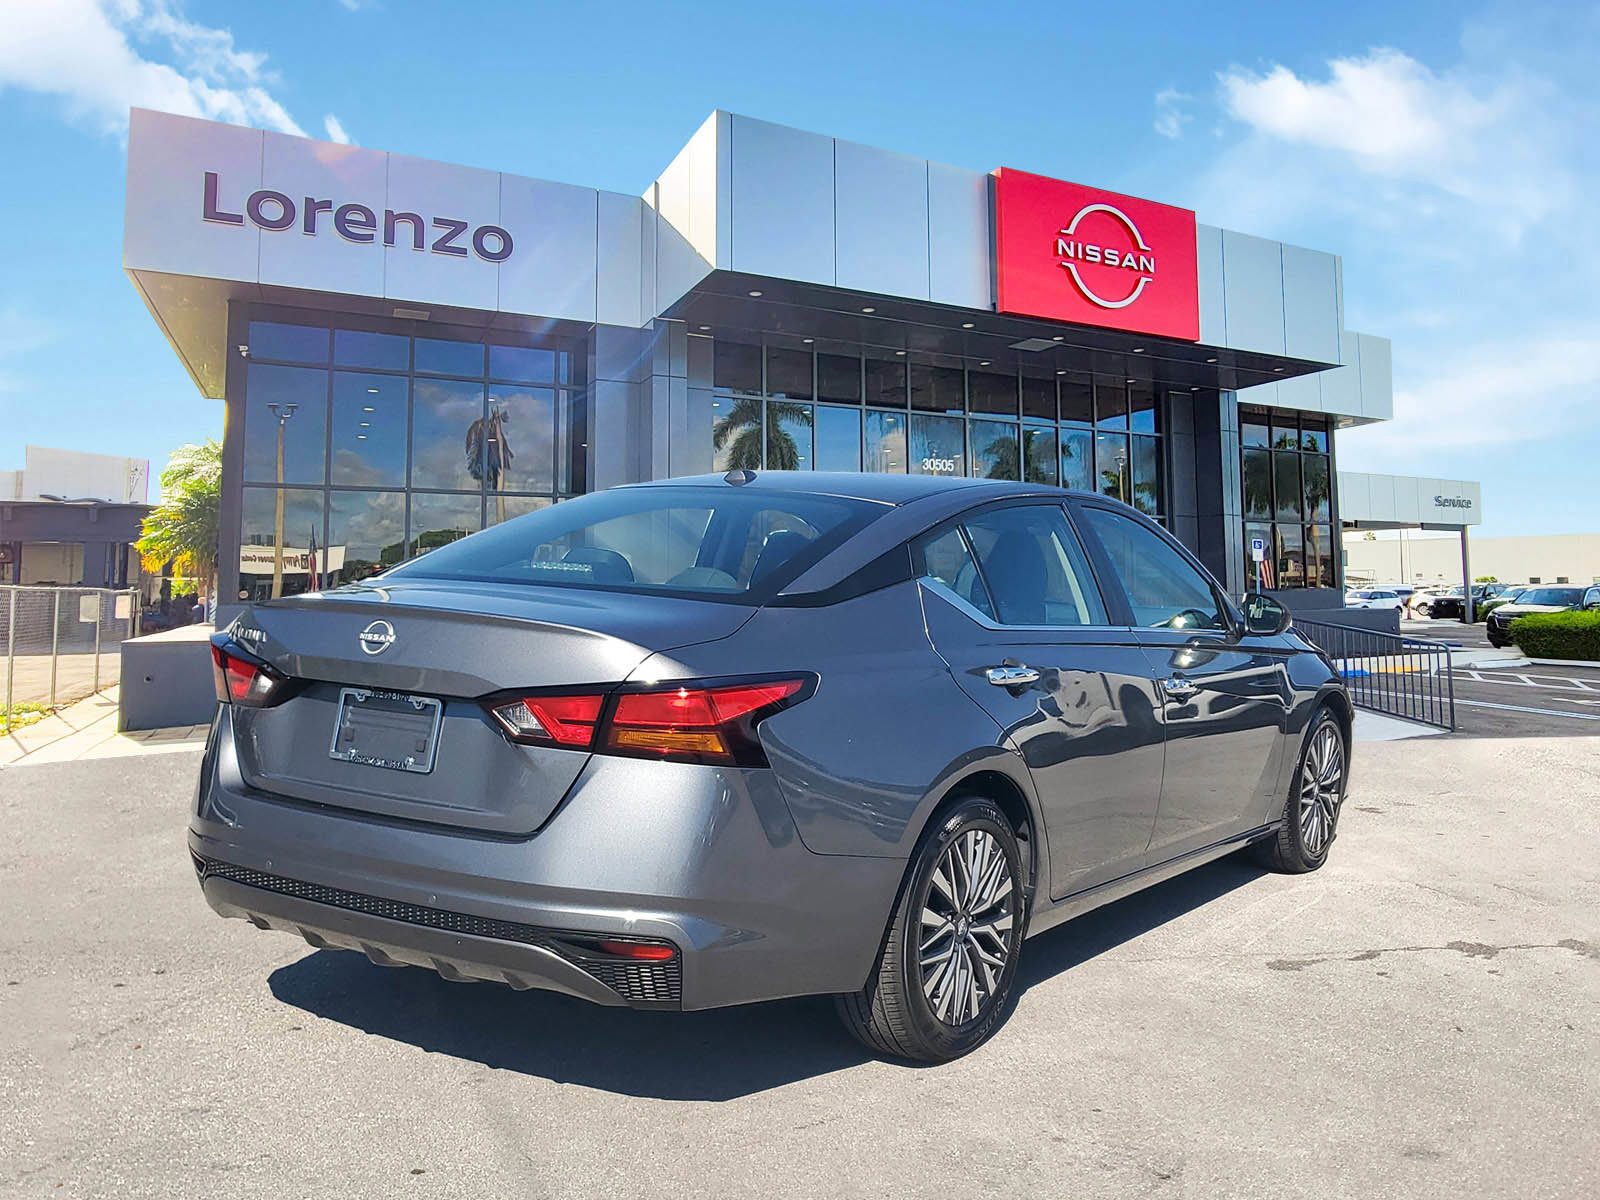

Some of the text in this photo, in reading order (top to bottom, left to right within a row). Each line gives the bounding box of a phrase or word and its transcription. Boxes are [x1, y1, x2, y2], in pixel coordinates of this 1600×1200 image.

[203, 171, 514, 262] Lorenzo
[1057, 237, 1155, 273] NISSAN
[922, 458, 954, 471] 30505
[1434, 495, 1472, 509] Service
[360, 632, 396, 643] NISSAN
